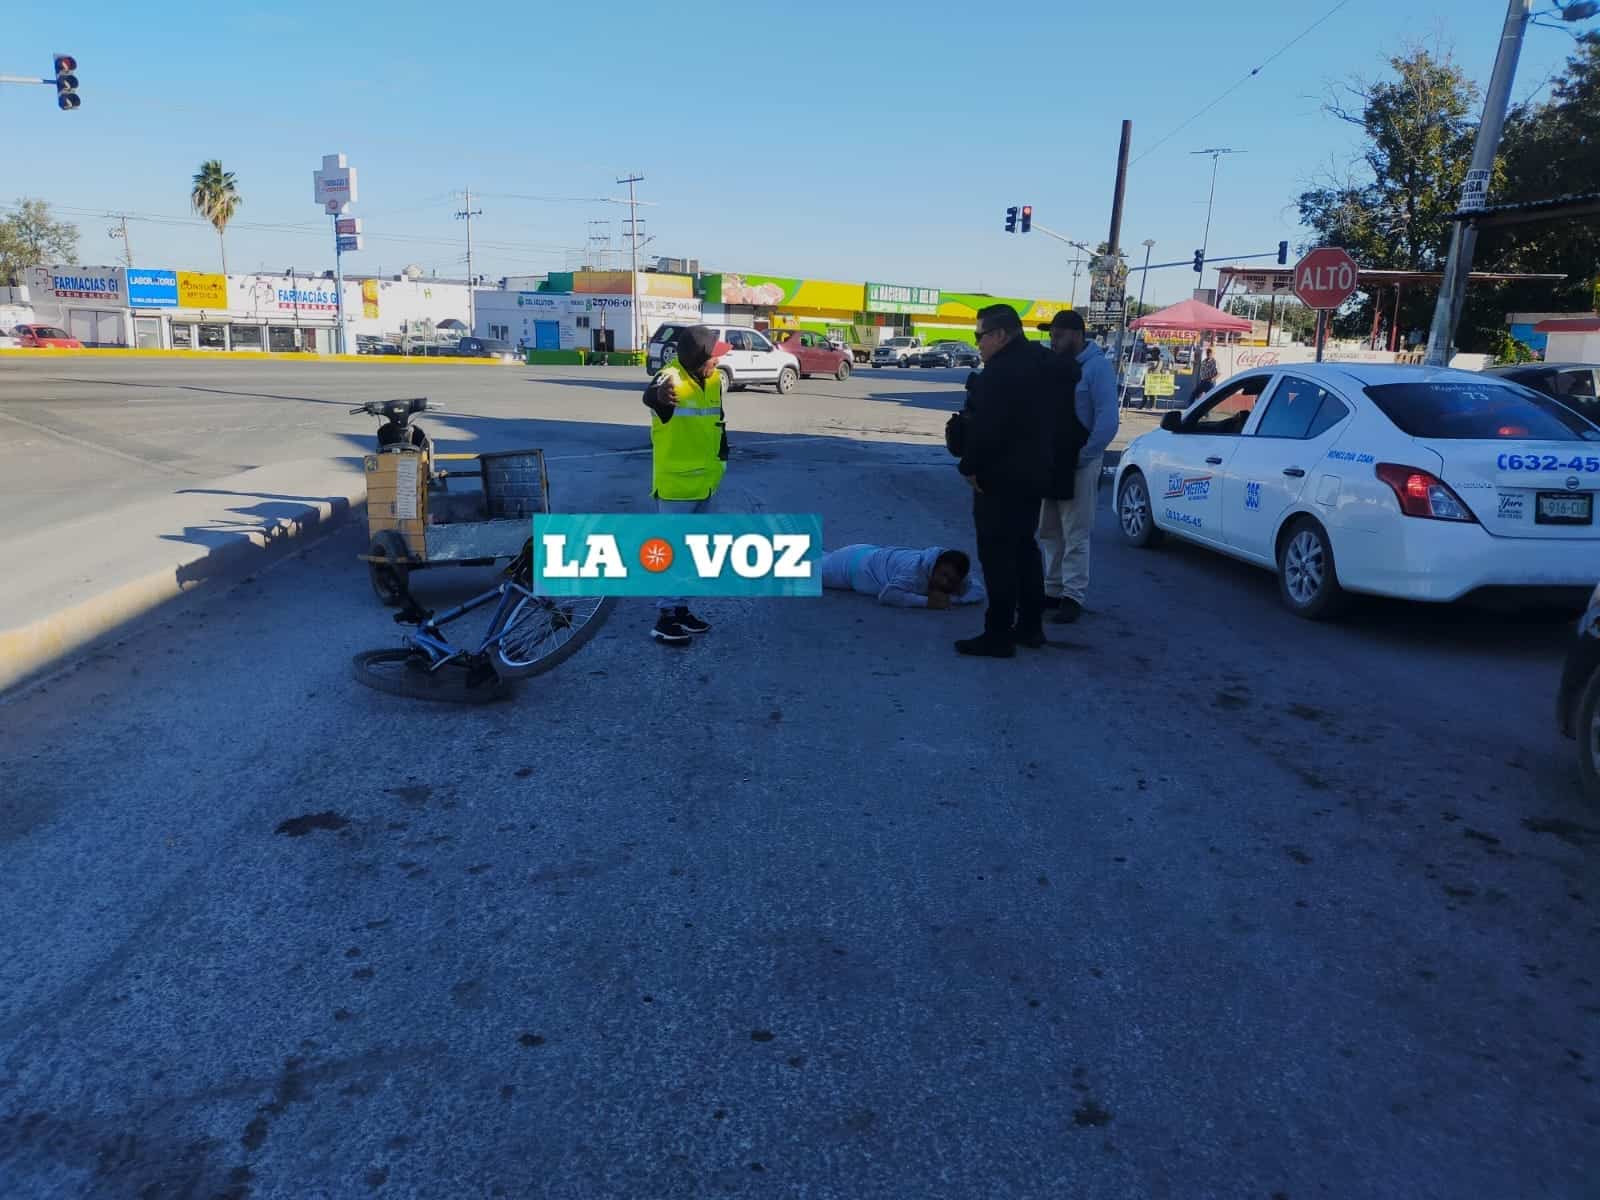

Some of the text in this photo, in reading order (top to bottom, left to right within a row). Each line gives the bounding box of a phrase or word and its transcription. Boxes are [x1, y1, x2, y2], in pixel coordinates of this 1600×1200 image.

[54, 276, 119, 292] FARMACIAS GI
[1300, 264, 1352, 290] ALTO
[278, 289, 328, 304] FARMACIAS
